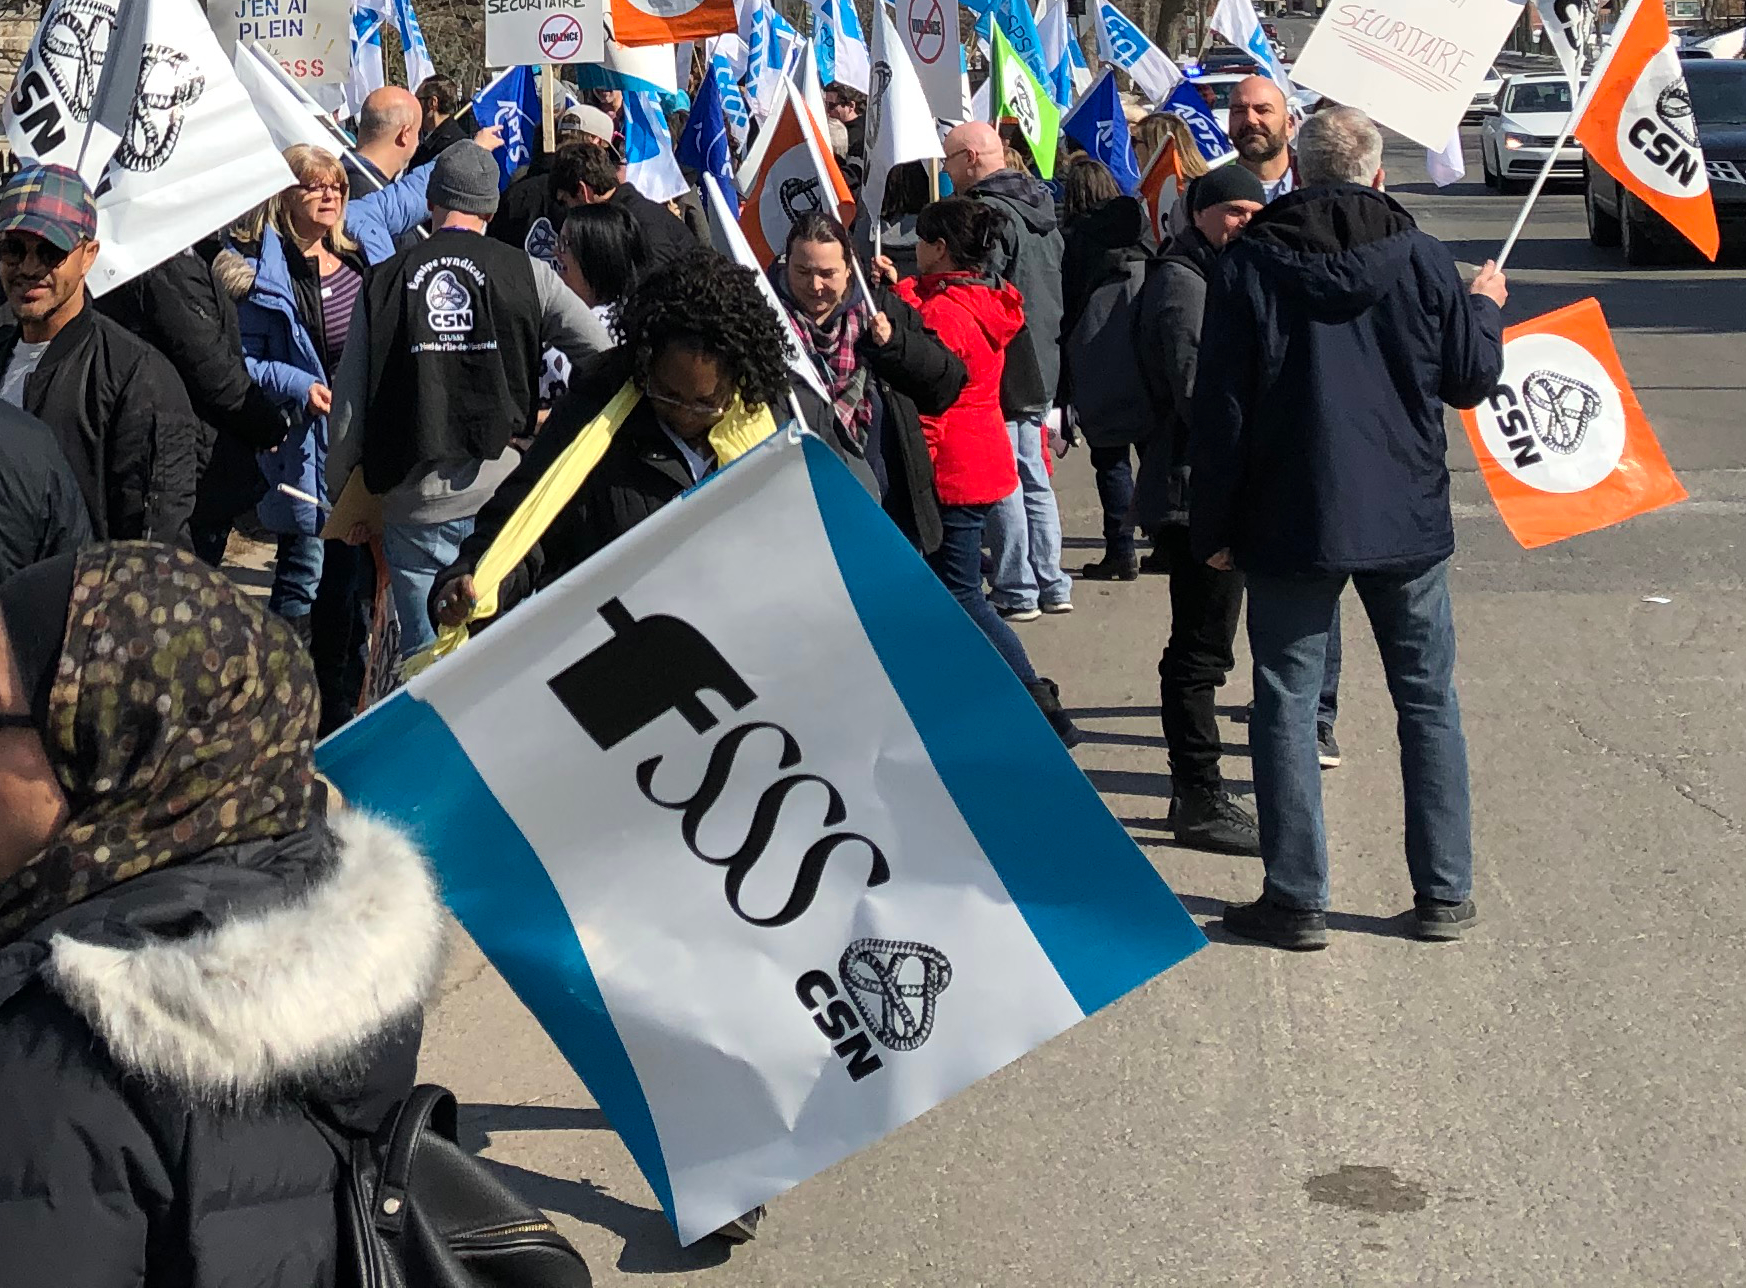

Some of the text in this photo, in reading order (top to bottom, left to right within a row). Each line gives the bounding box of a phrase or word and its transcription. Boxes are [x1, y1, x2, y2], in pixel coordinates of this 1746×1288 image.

[239, 19, 304, 41] PLEIN
[10, 48, 66, 157] SN
[1172, 102, 1225, 158] APTS
[1628, 117, 1700, 189] CSN
[431, 312, 472, 328] CSN
[1488, 384, 1544, 469] CSN
[794, 968, 884, 1083] CSN
